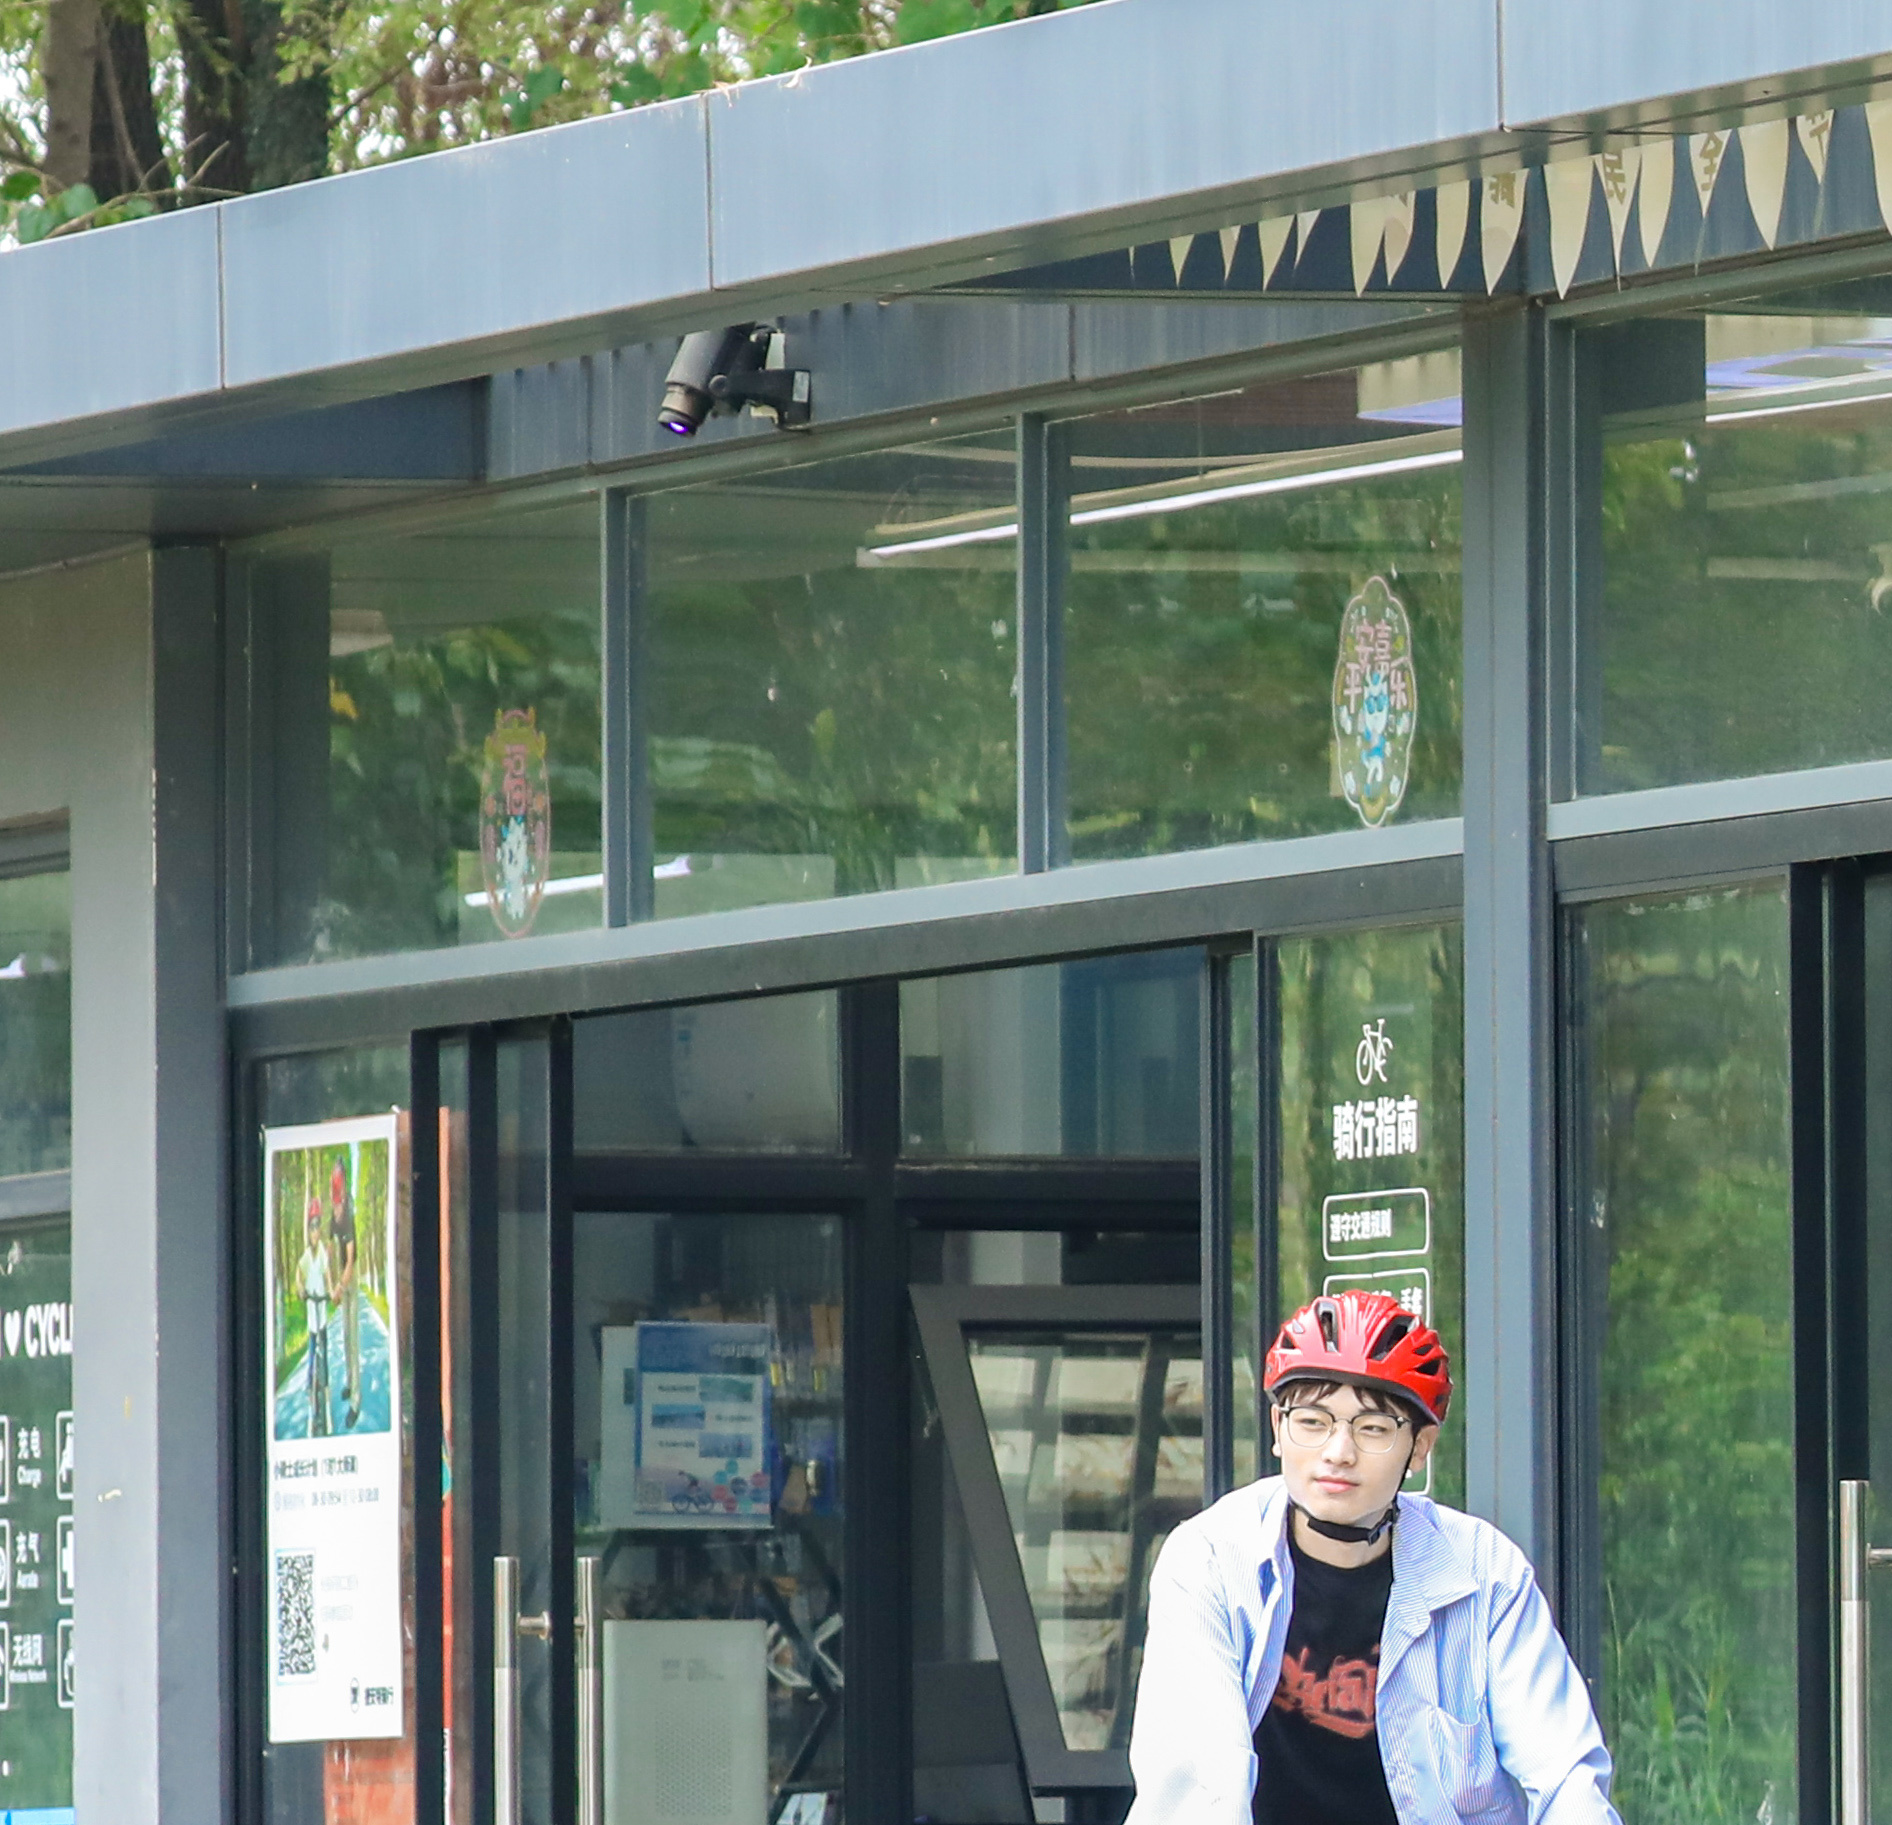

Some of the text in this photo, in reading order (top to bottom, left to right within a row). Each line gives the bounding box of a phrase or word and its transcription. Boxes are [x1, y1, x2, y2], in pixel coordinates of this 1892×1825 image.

[1331, 1094, 1419, 1162] 骑行指南
[15, 1530, 41, 1564] 充气
